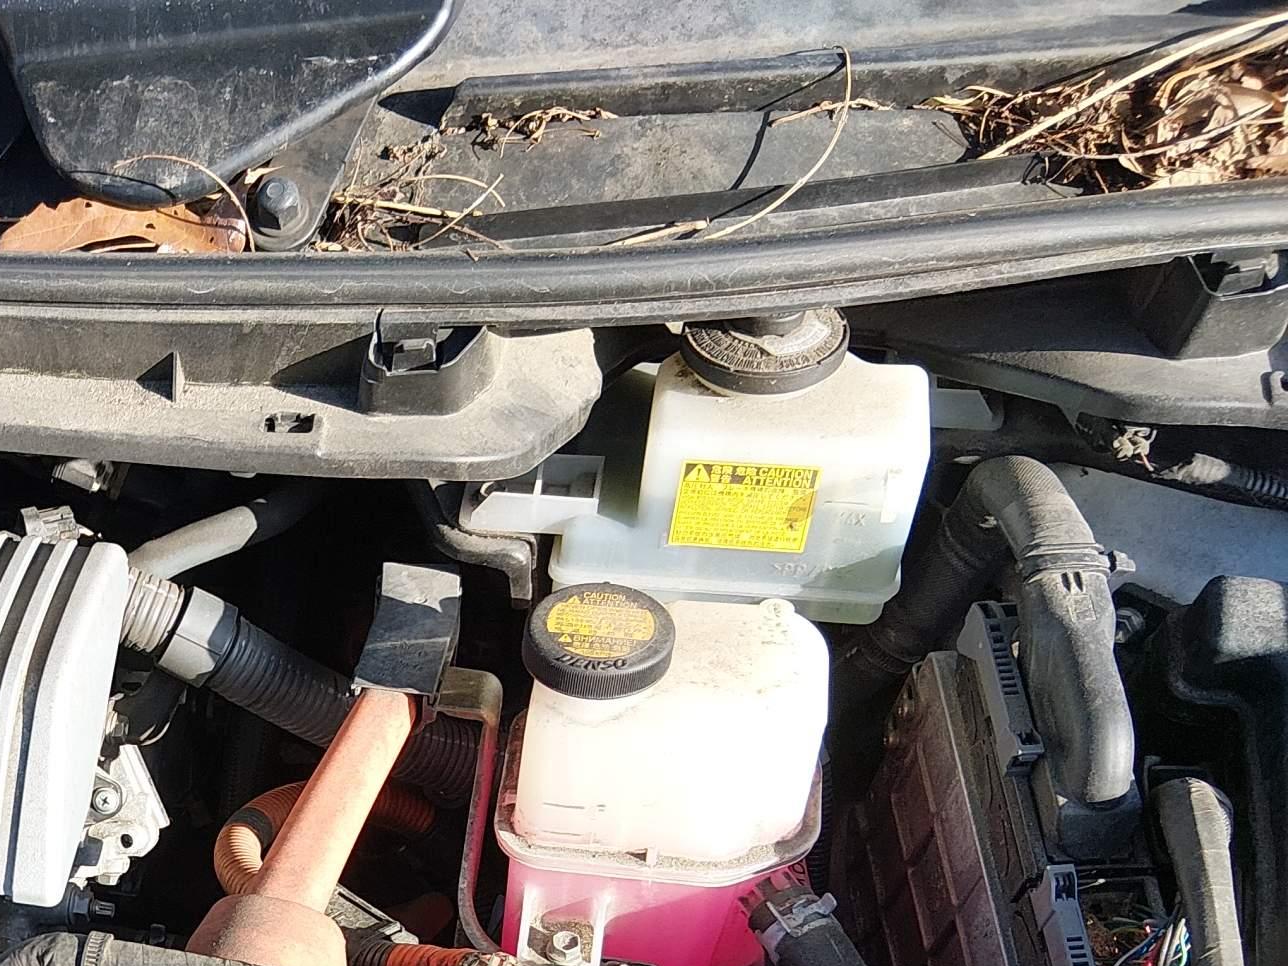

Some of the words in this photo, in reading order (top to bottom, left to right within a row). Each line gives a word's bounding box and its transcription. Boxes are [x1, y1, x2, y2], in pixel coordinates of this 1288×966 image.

[759, 468, 812, 479] CAUTION
[743, 476, 811, 489] ATTENTION
[584, 591, 626, 602] CAUTION
[582, 599, 638, 609] ATTENTION
[554, 654, 628, 671] DENSO
